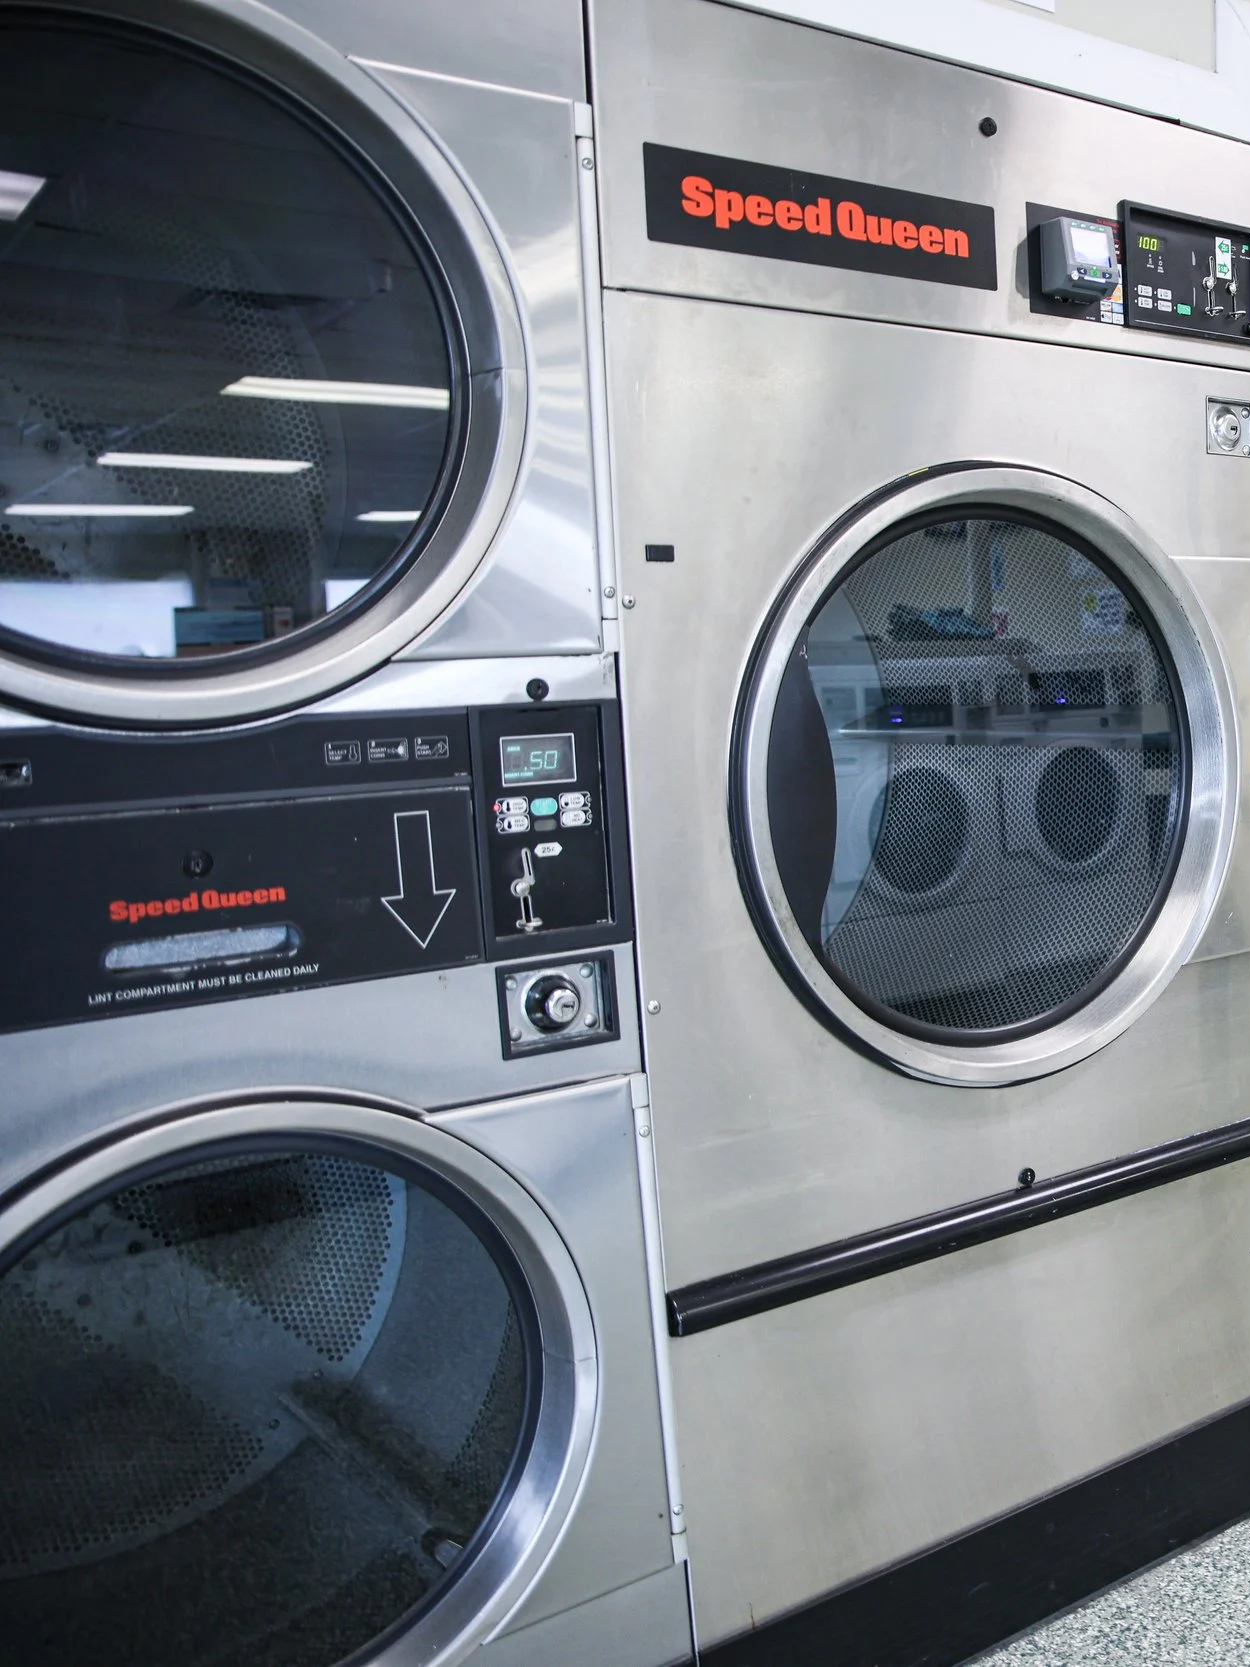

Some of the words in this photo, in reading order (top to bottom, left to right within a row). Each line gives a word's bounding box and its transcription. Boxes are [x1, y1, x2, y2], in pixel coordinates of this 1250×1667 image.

[681, 175, 832, 236] Speed
[836, 200, 970, 258] Queen
[1139, 236, 1158, 251] 100
[524, 750, 558, 771] .50
[109, 891, 199, 924] Speed
[202, 886, 286, 910] Queen
[88, 992, 112, 1005] LINT
[115, 981, 195, 1000] COMPARTMENT
[198, 976, 227, 989] MUST
[229, 973, 243, 985] BE
[245, 967, 291, 982] CLEANED
[293, 963, 320, 977] DAILY
